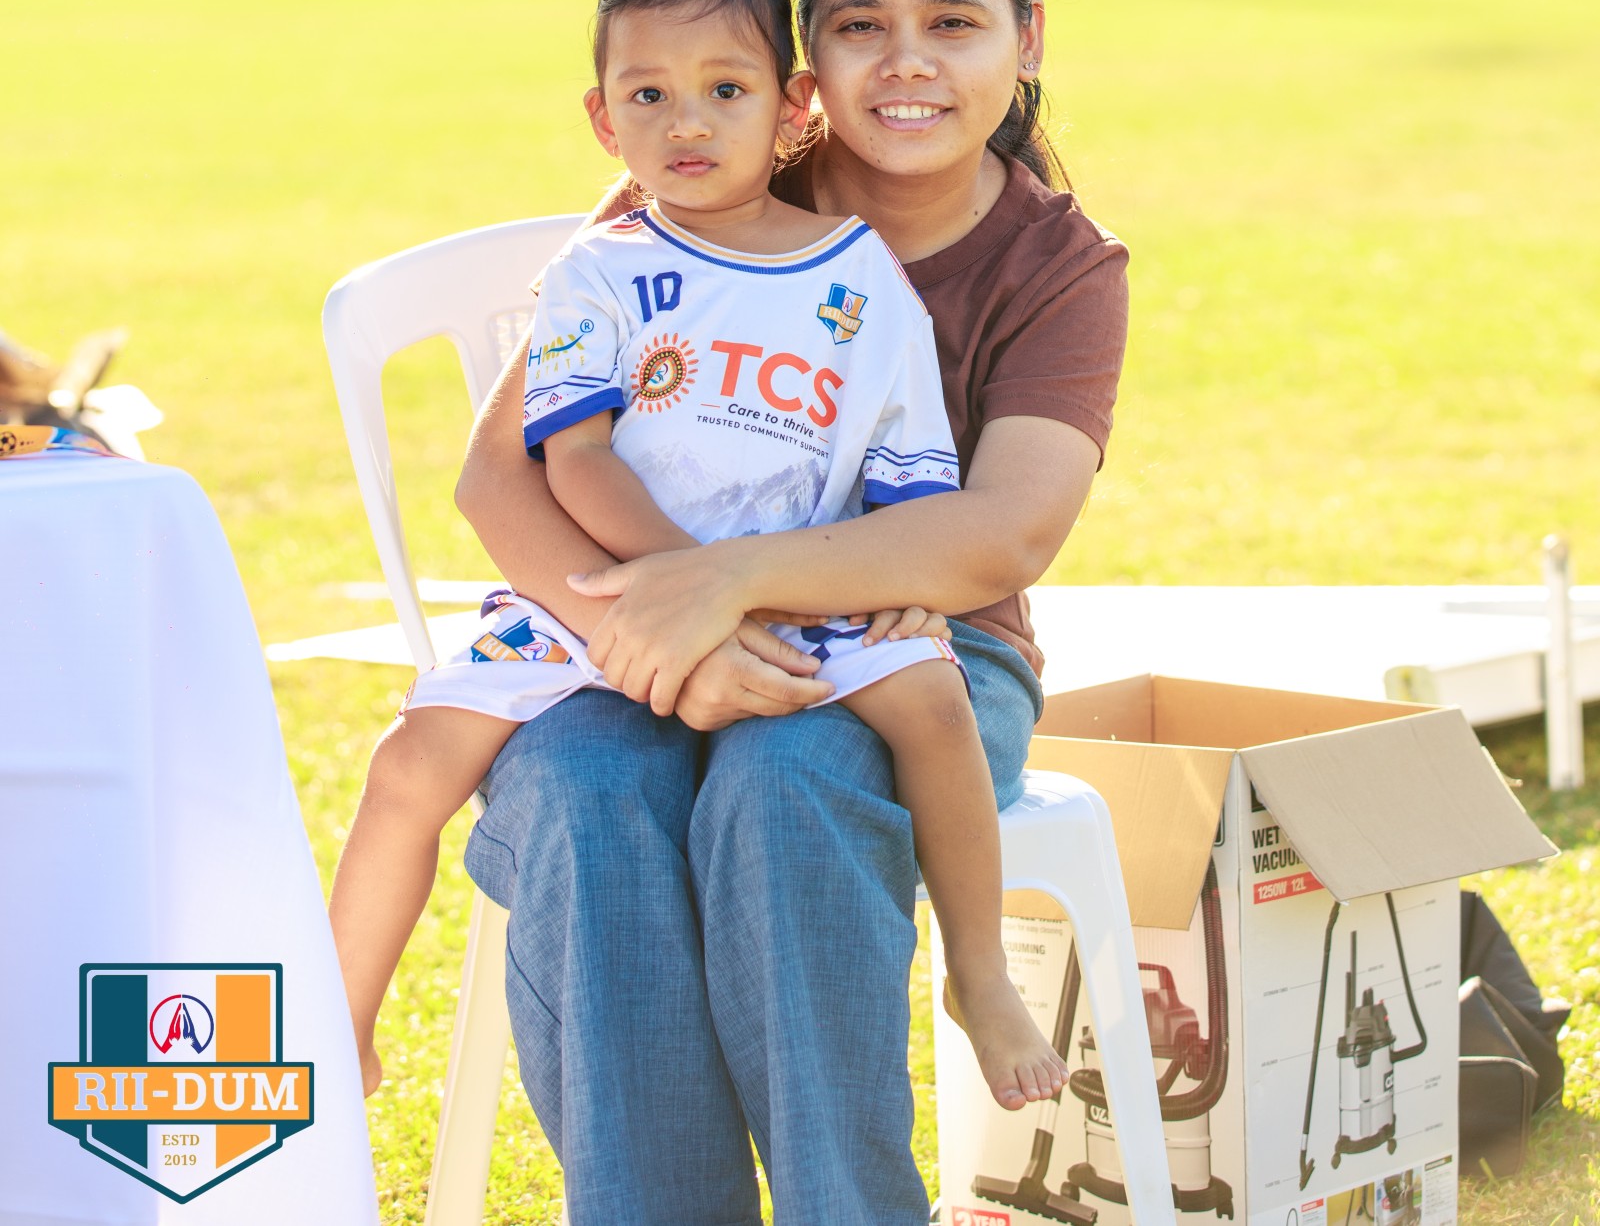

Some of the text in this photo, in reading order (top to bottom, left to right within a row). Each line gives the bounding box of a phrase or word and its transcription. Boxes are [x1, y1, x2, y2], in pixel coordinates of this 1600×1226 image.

[631, 271, 682, 323] 10
[711, 340, 844, 428] TCS
[697, 415, 829, 459] TRUSTED COMMUNITY SUPPORT
[728, 403, 814, 438] Care to thrive
[1252, 826, 1280, 849] WET
[1258, 877, 1307, 900] 1250W 12L
